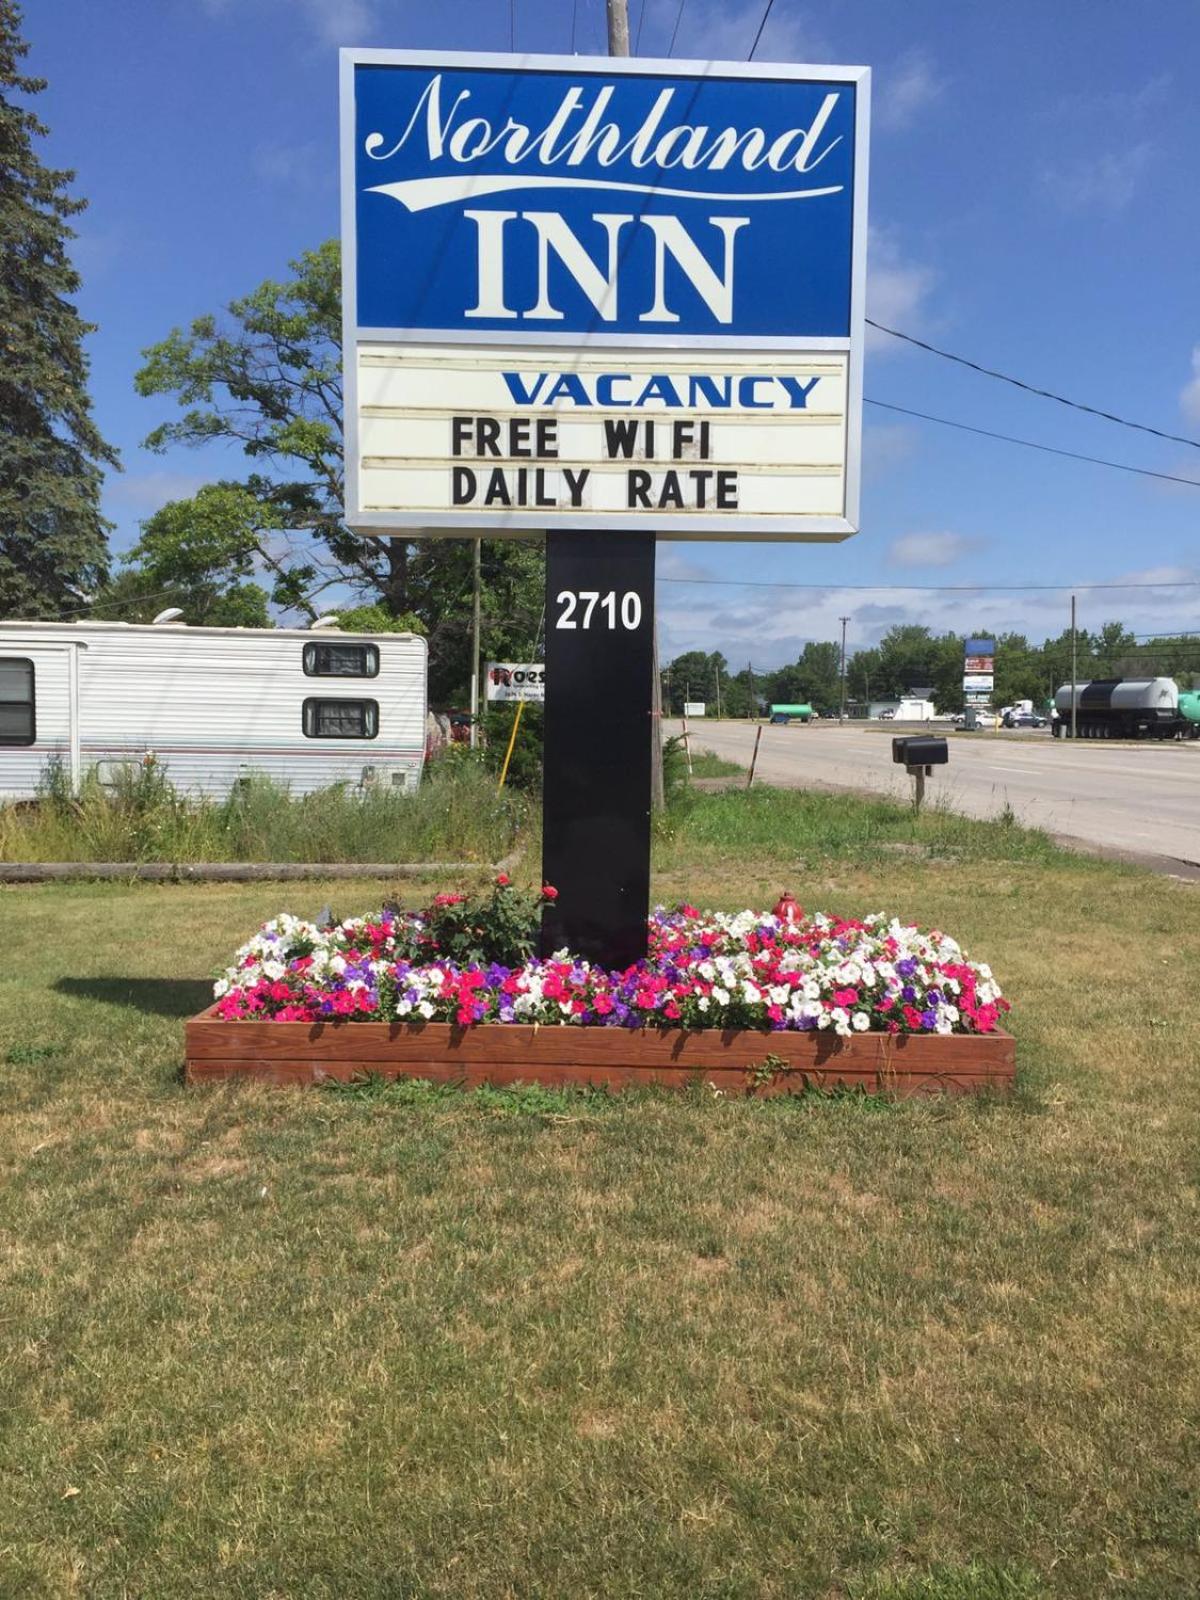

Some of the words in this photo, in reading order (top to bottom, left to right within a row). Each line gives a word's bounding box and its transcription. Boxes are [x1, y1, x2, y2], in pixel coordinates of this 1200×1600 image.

[365, 73, 843, 173] Northland
[464, 209, 750, 324] INN
[502, 372, 821, 409] VACANCY
[453, 416, 558, 458] FREE
[453, 466, 590, 507] DAILY
[628, 469, 738, 509] RATE
[555, 590, 642, 630] 2710
